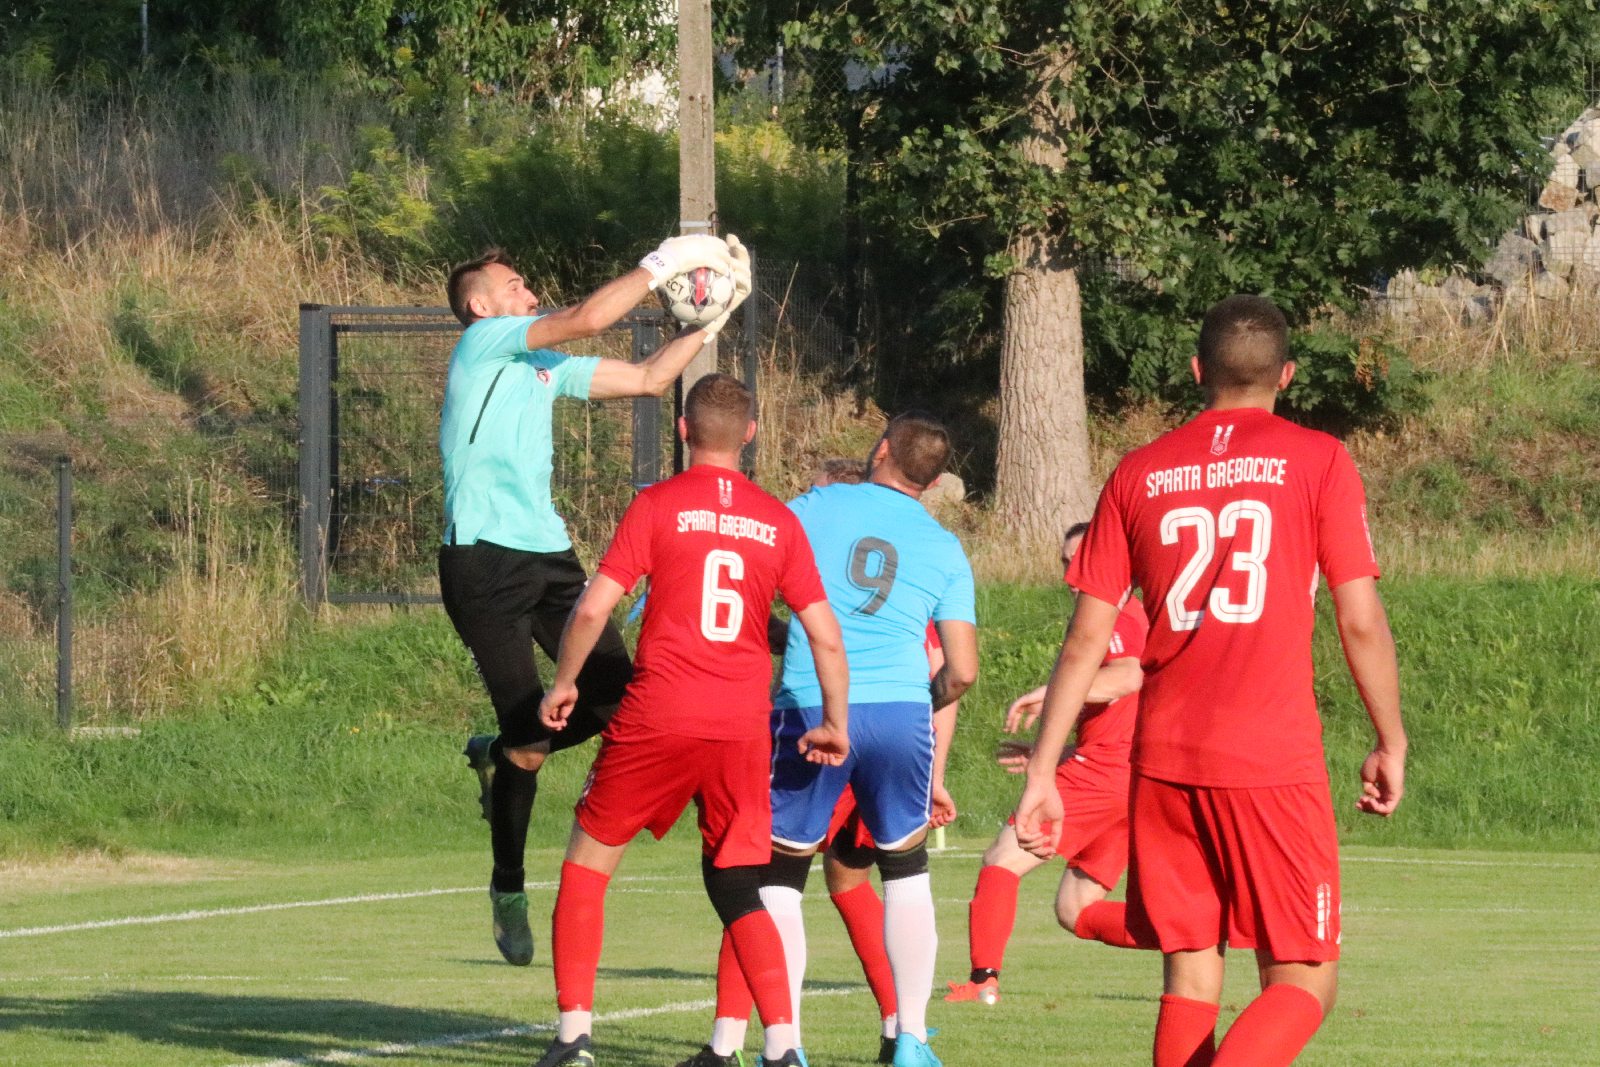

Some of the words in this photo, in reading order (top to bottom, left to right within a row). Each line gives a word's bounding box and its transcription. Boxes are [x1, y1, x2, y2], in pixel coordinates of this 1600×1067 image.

[1146, 465, 1201, 498] SPARTA
[1207, 457, 1287, 488] GRĘBOCICE
[677, 509, 717, 533] SPARTA
[718, 514, 777, 547] GRĘBOCICE
[1160, 499, 1273, 632] 23
[701, 549, 744, 642] 6
[846, 536, 898, 617] 9
